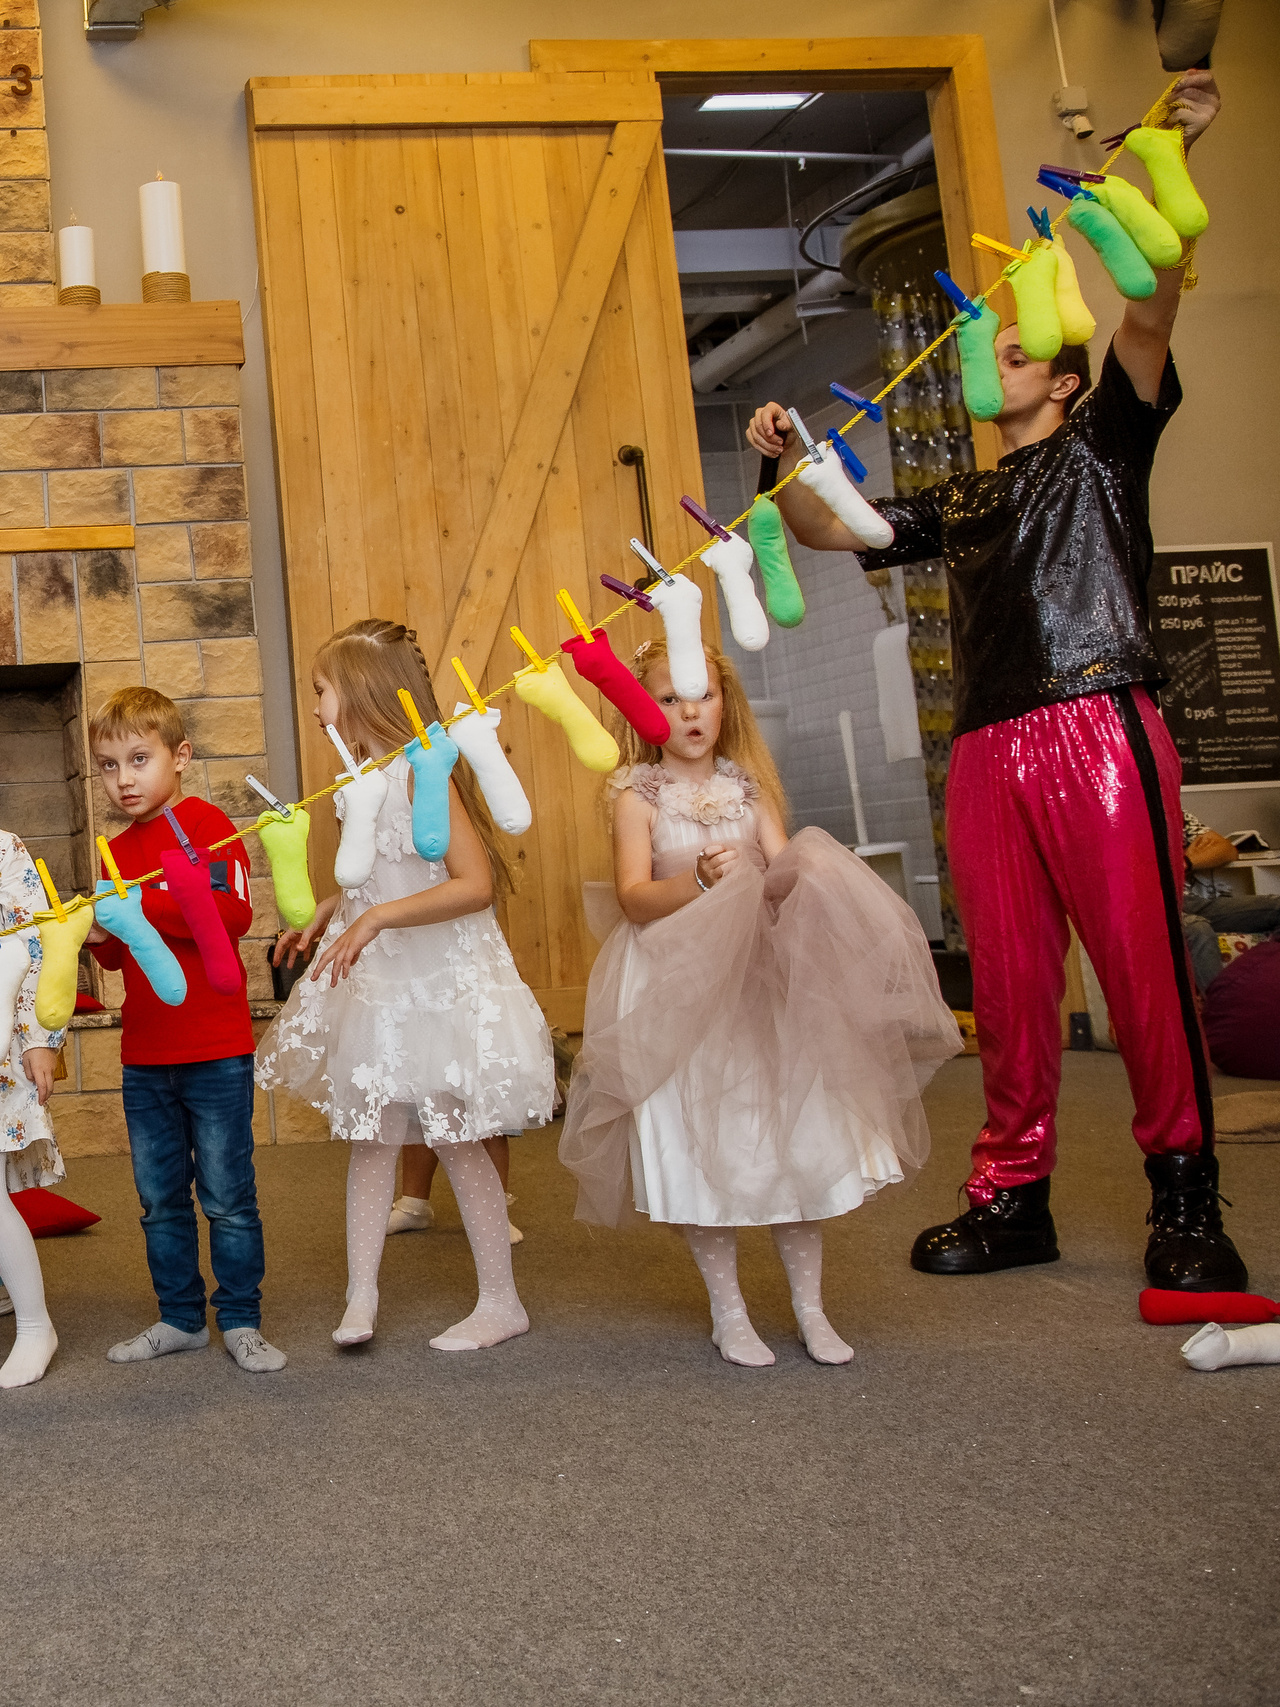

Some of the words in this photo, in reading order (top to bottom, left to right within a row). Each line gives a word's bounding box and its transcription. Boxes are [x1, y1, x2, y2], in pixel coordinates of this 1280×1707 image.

[10, 64, 32, 96] 3
[1170, 561, 1243, 585] ПРАЙС
[1180, 594, 1203, 608] руб.
[1160, 617, 1180, 630] 250
[1182, 617, 1206, 630] руб.
[1194, 706, 1218, 720] руб.
